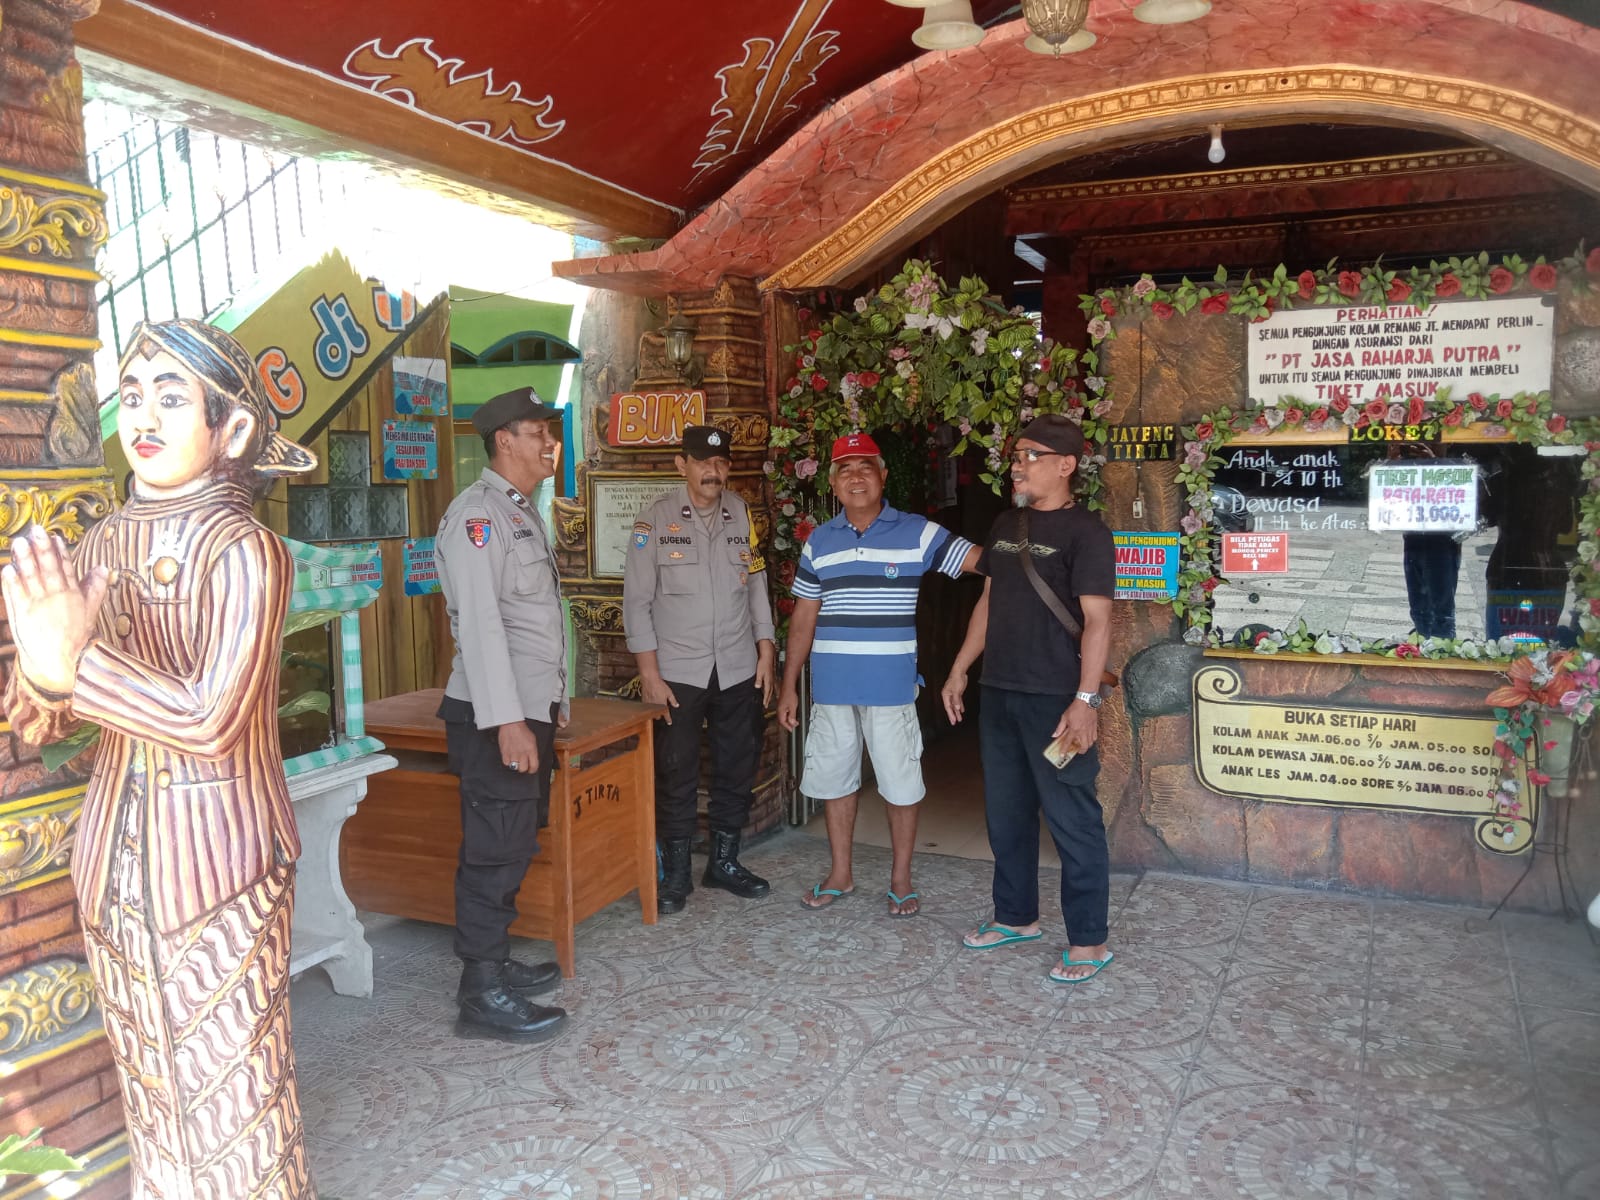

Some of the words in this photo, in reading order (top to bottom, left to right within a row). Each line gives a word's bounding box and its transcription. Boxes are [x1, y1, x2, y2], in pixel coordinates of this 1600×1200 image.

[1259, 328, 1289, 341] SEMUA
[1292, 325, 1346, 339] PENGUNJUNG
[1349, 322, 1380, 336] KOLAM
[1384, 320, 1421, 334] RENANG
[1442, 318, 1490, 331] MENDAPAT
[1312, 337, 1349, 350] DUNGAN
[1354, 335, 1403, 348] ASURANSI
[1409, 334, 1433, 346] DARI
[1311, 351, 1355, 368] JASA
[1361, 348, 1434, 366] RAHARJA
[1259, 373, 1289, 384] UNTUK
[1292, 371, 1308, 383] ITU
[1311, 370, 1341, 383] SEMUA
[1344, 368, 1401, 381] PENGUNJUNG
[1407, 366, 1463, 379] DIWAJIBKAN
[1470, 364, 1520, 376] MEMBELI
[1315, 383, 1364, 399] TIKET
[1375, 381, 1439, 398] MASUK
[618, 392, 706, 444] BUKA
[1110, 425, 1174, 442] JAYENG
[1113, 443, 1169, 459] TIRTA
[1301, 470, 1317, 487] 10
[1322, 470, 1343, 488] th
[1375, 469, 1418, 486] TIKET
[1421, 468, 1474, 487] MASUK
[1231, 494, 1321, 513] Dewasa
[1383, 487, 1465, 504] RATA-RATA
[1271, 515, 1289, 531] th
[659, 536, 692, 545] SUGENG
[1129, 536, 1177, 546] PENGUNJUNG
[1115, 547, 1166, 565] WAJIB
[1116, 566, 1162, 576] MEMBAYAR
[1117, 578, 1134, 588] IKET
[1136, 579, 1166, 588] MASUK
[1284, 710, 1326, 726] BUKA
[1330, 713, 1378, 730] SETIAP
[1383, 717, 1417, 732] HARI
[1213, 725, 1252, 739] KOLAM
[1257, 729, 1289, 741] ANAK
[1212, 744, 1254, 757] KOLAM
[1258, 748, 1306, 761] DEWASA
[1221, 765, 1253, 777] ANAK
[1258, 767, 1281, 779] LES
[1361, 777, 1395, 789] SORE
[1415, 782, 1442, 795] JAM
[585, 783, 620, 805] TIRTA
